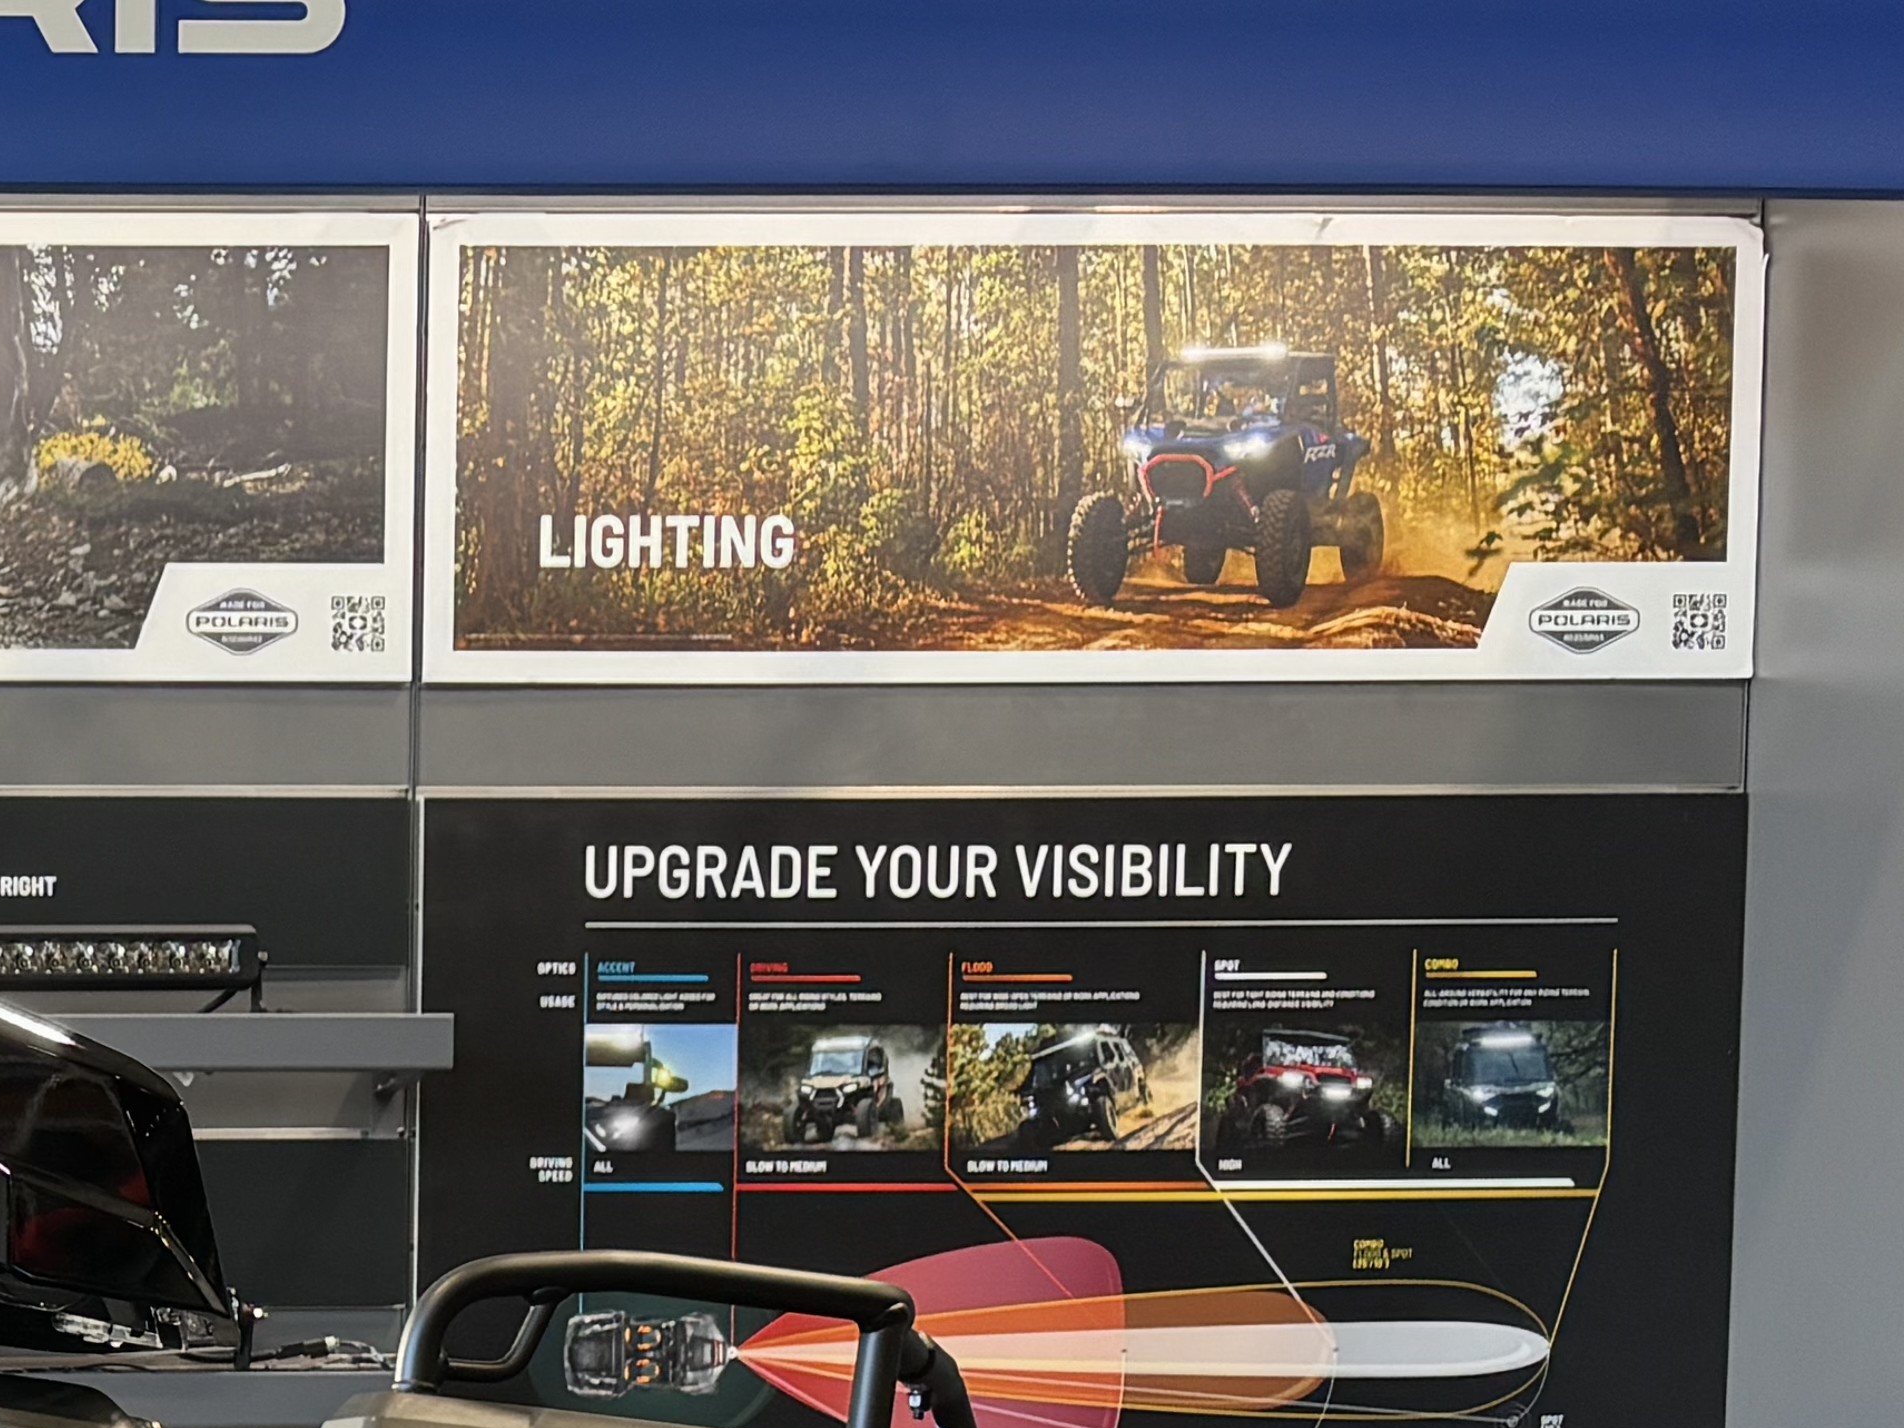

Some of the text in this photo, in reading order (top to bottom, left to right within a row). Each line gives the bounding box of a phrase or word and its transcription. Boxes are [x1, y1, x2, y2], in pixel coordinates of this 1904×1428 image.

[538, 514, 796, 570] LIGHTING
[195, 616, 289, 628] POLARIS
[1538, 614, 1630, 626] POLARIS
[583, 843, 1294, 902] UPGRADE YOUR VISIBILITY
[597, 961, 636, 974] ACCENT
[961, 961, 993, 973] FLOOD
[1214, 959, 1240, 972] SPOT
[1424, 958, 1460, 971] COMBO
[539, 995, 576, 1009] USAGE
[593, 1160, 613, 1174] ALL
[745, 1160, 827, 1173] SLOW TO MEDIUM
[967, 1159, 1049, 1173] SLOW TO MEDIUM
[1431, 1157, 1451, 1170] ALL
[538, 1169, 573, 1182] SPEED
